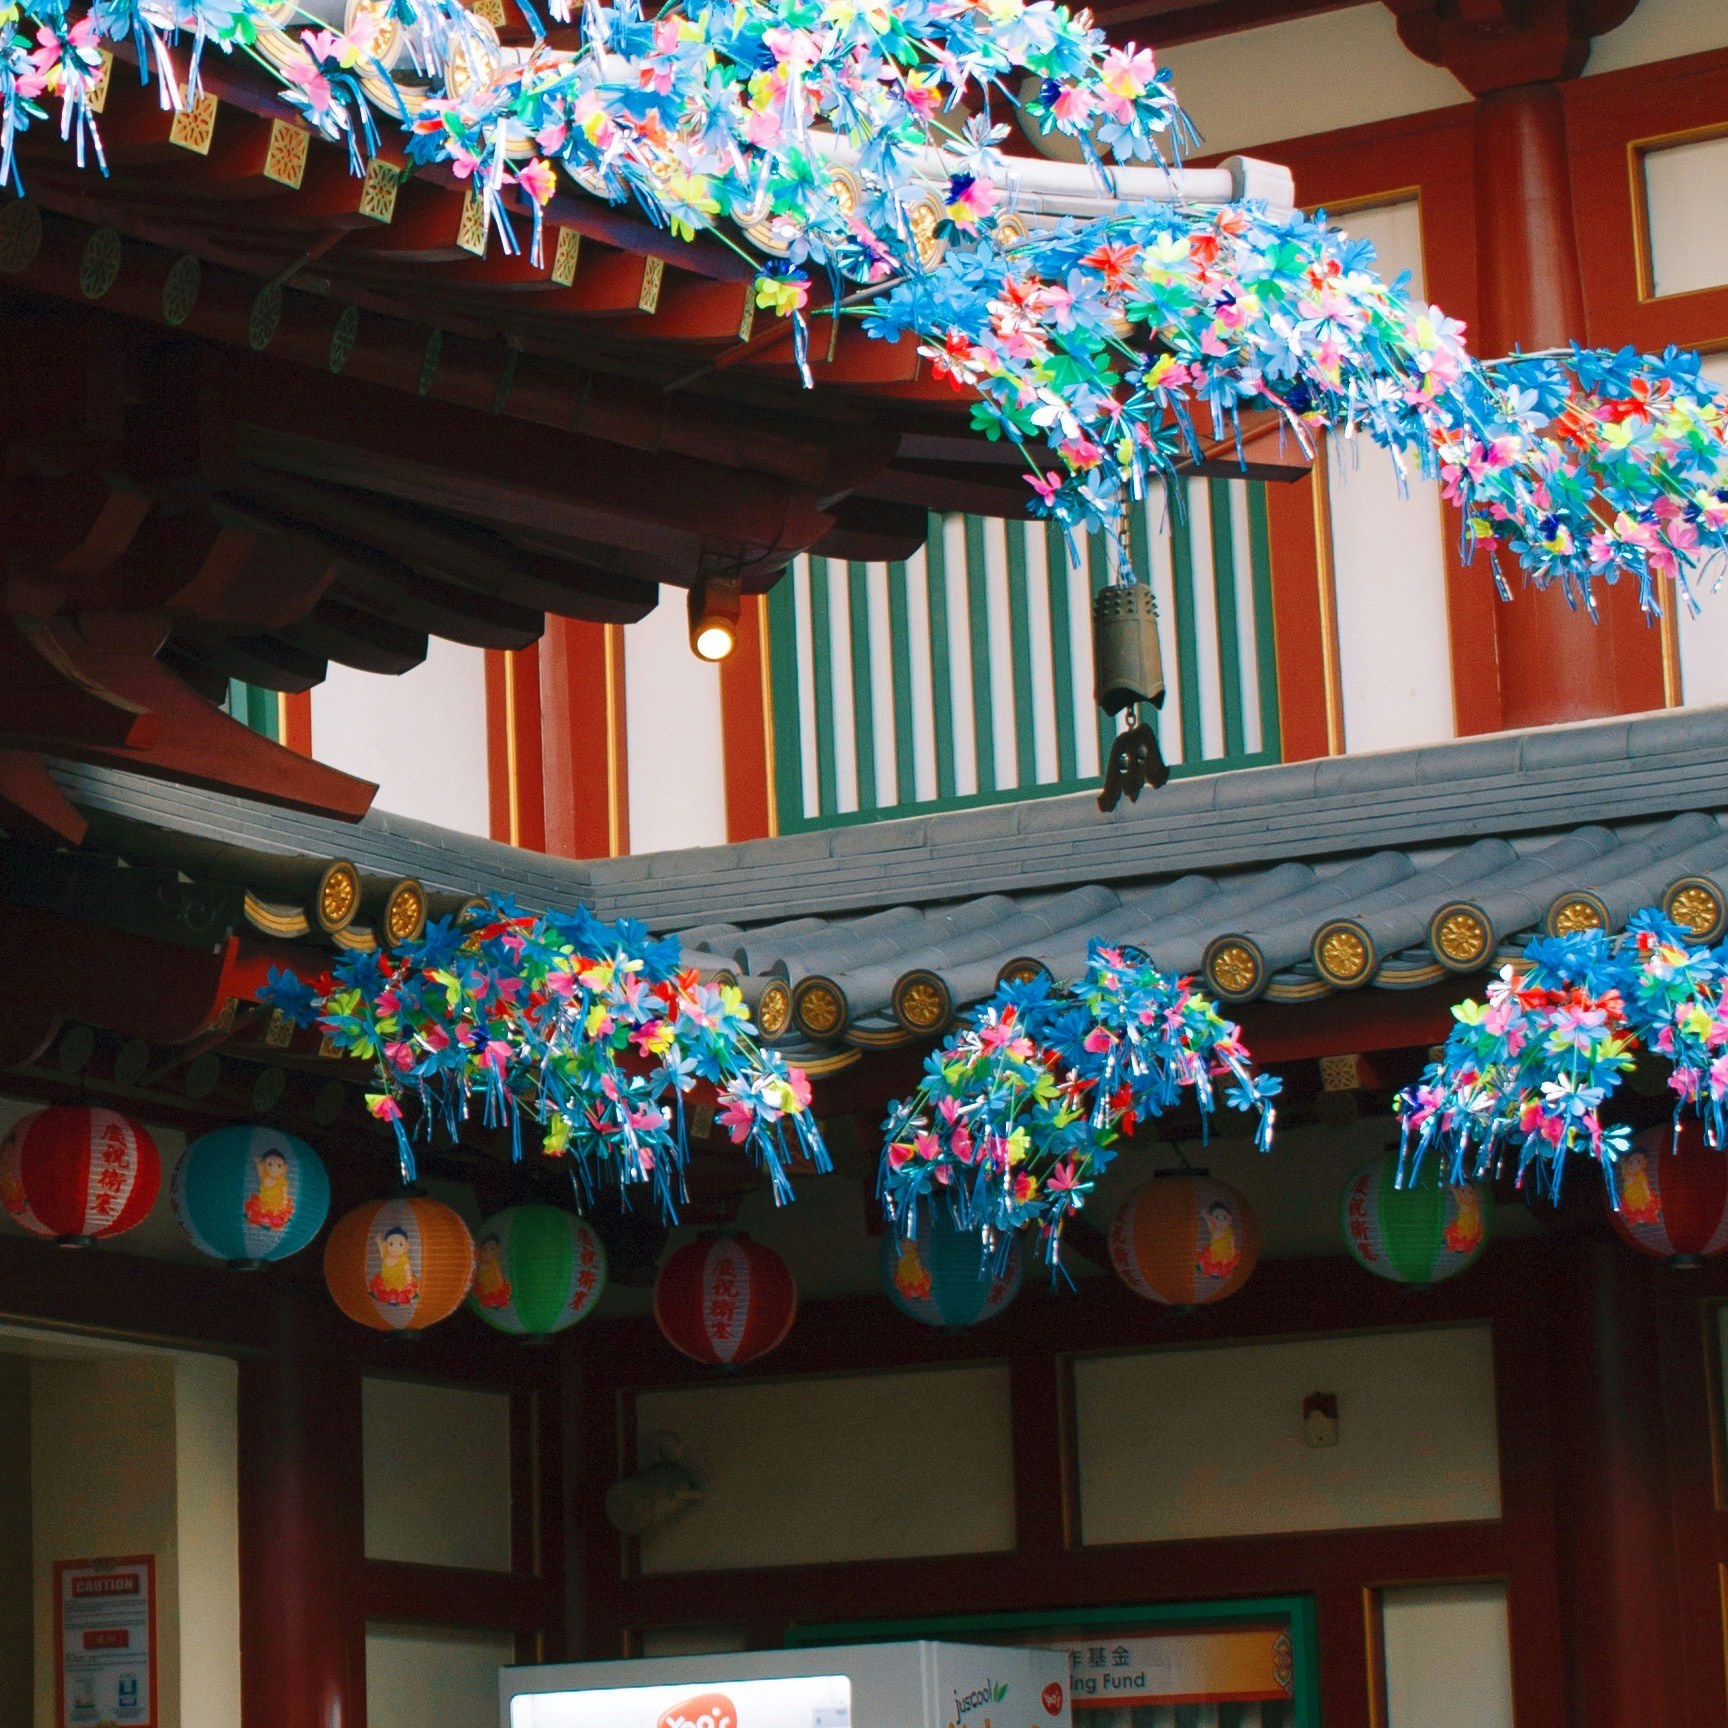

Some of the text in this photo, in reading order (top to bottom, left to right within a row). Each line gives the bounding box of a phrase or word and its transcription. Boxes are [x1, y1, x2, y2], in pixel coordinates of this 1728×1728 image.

[75, 1577, 134, 1594] CAUTION
[1071, 1672, 1146, 1694] ing Fund
